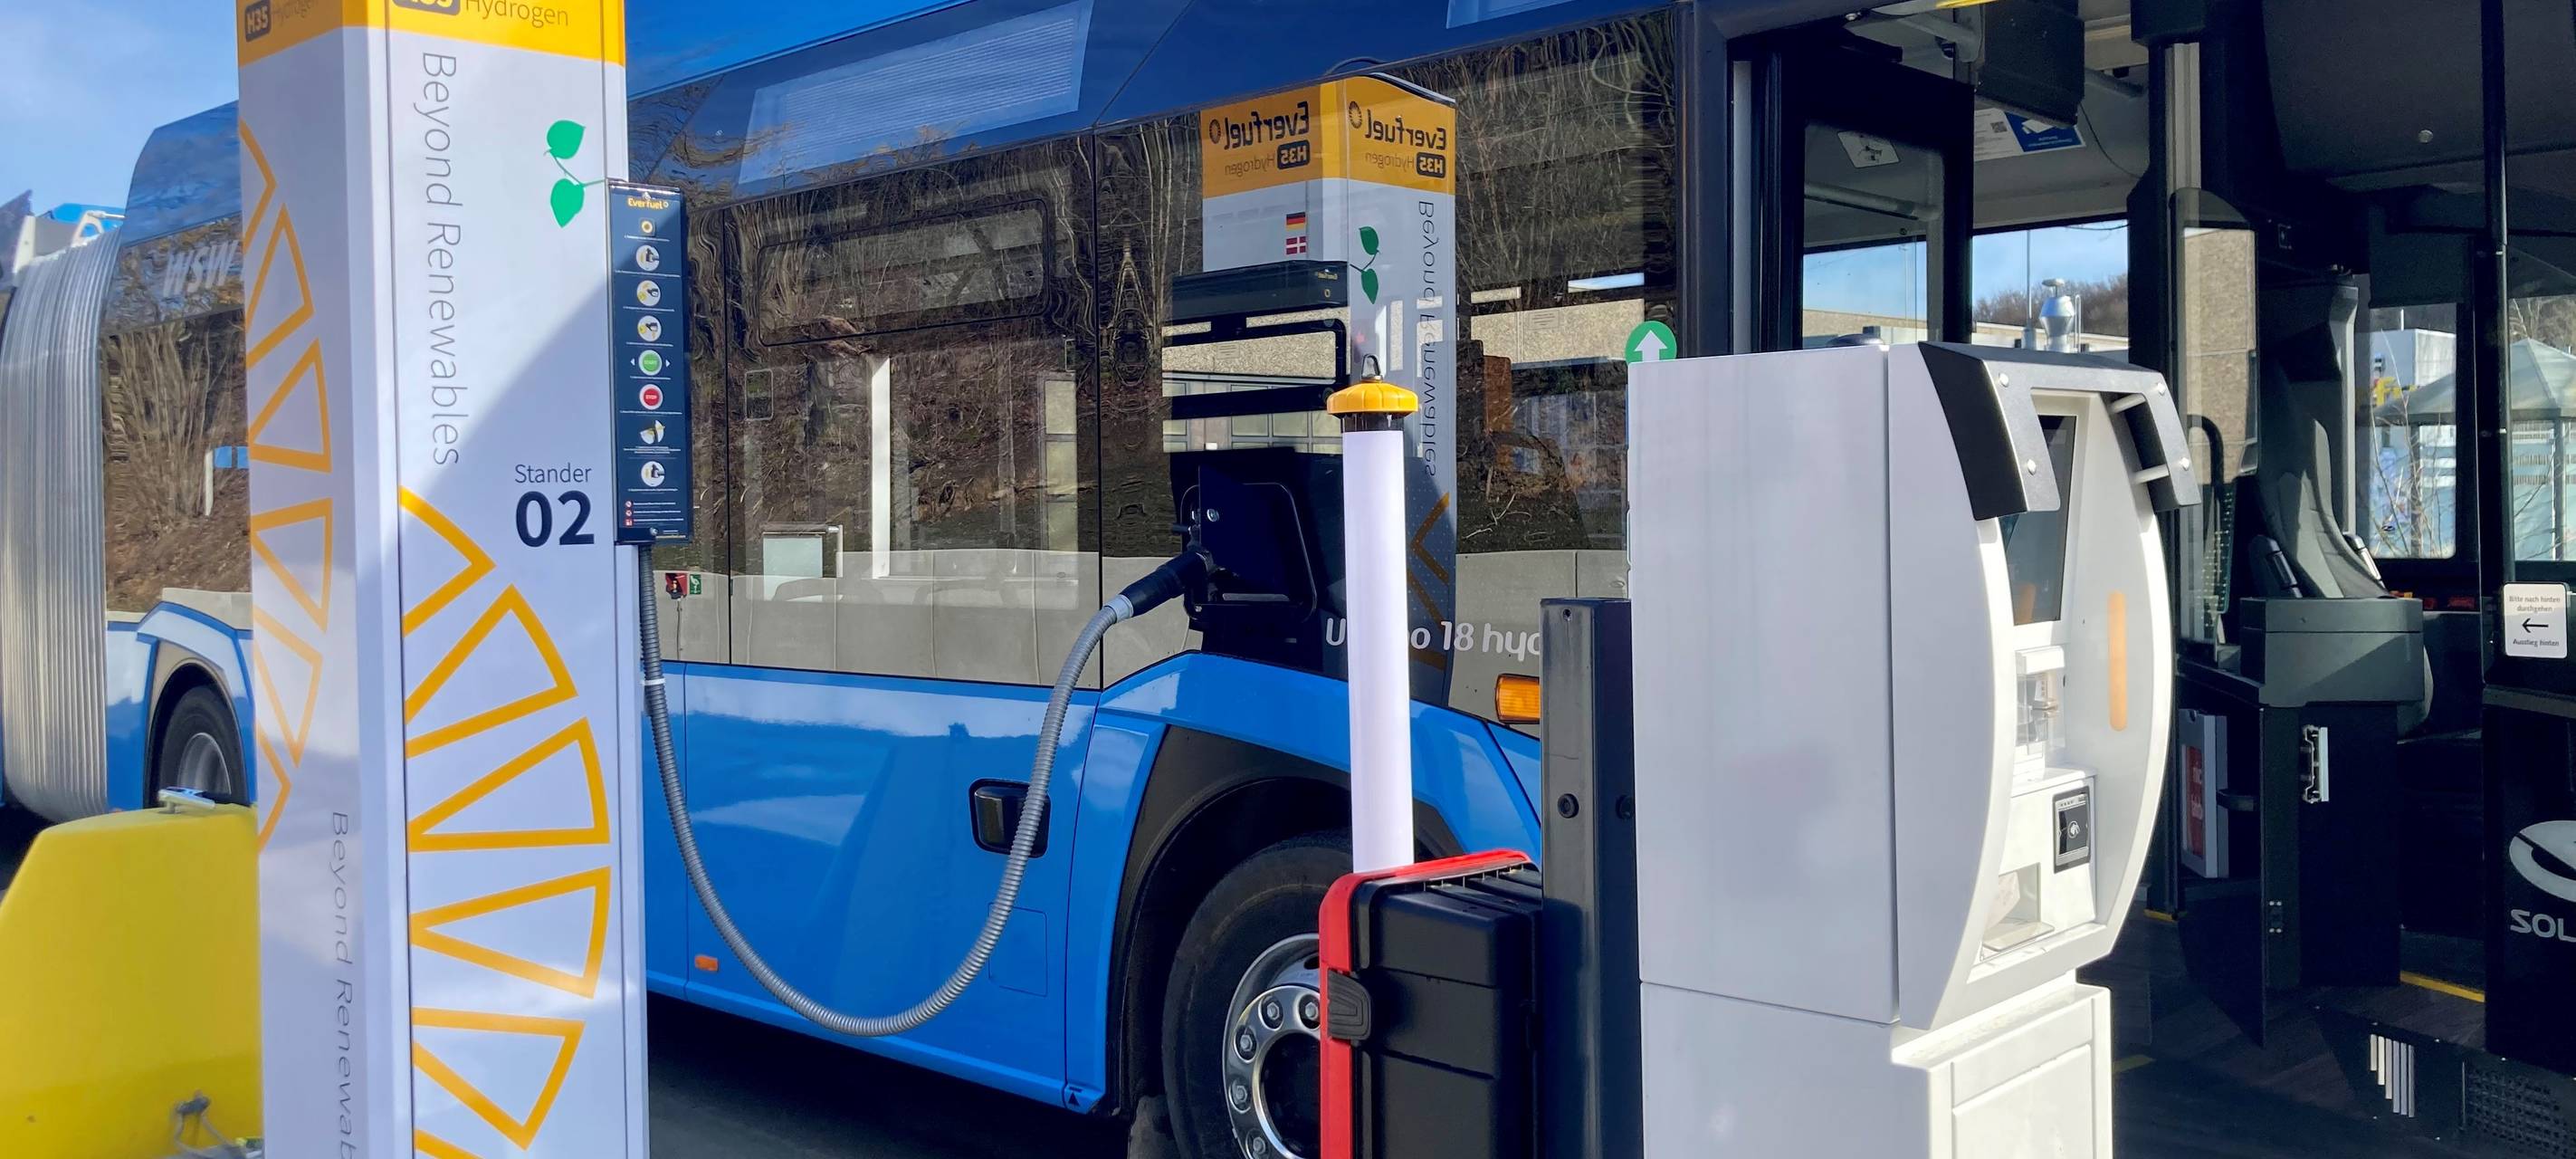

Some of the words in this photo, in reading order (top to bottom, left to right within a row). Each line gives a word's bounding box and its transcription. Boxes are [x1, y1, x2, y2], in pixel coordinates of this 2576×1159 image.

[245, 5, 270, 34] H35
[413, 53, 463, 206] Beyond
[627, 197, 663, 209] Everfuel
[163, 239, 240, 298] WSW
[427, 222, 469, 465] Renewables
[514, 462, 592, 484] Stander
[515, 490, 595, 548] 02
[1440, 620, 1474, 651] 18
[329, 811, 353, 966] Beyond
